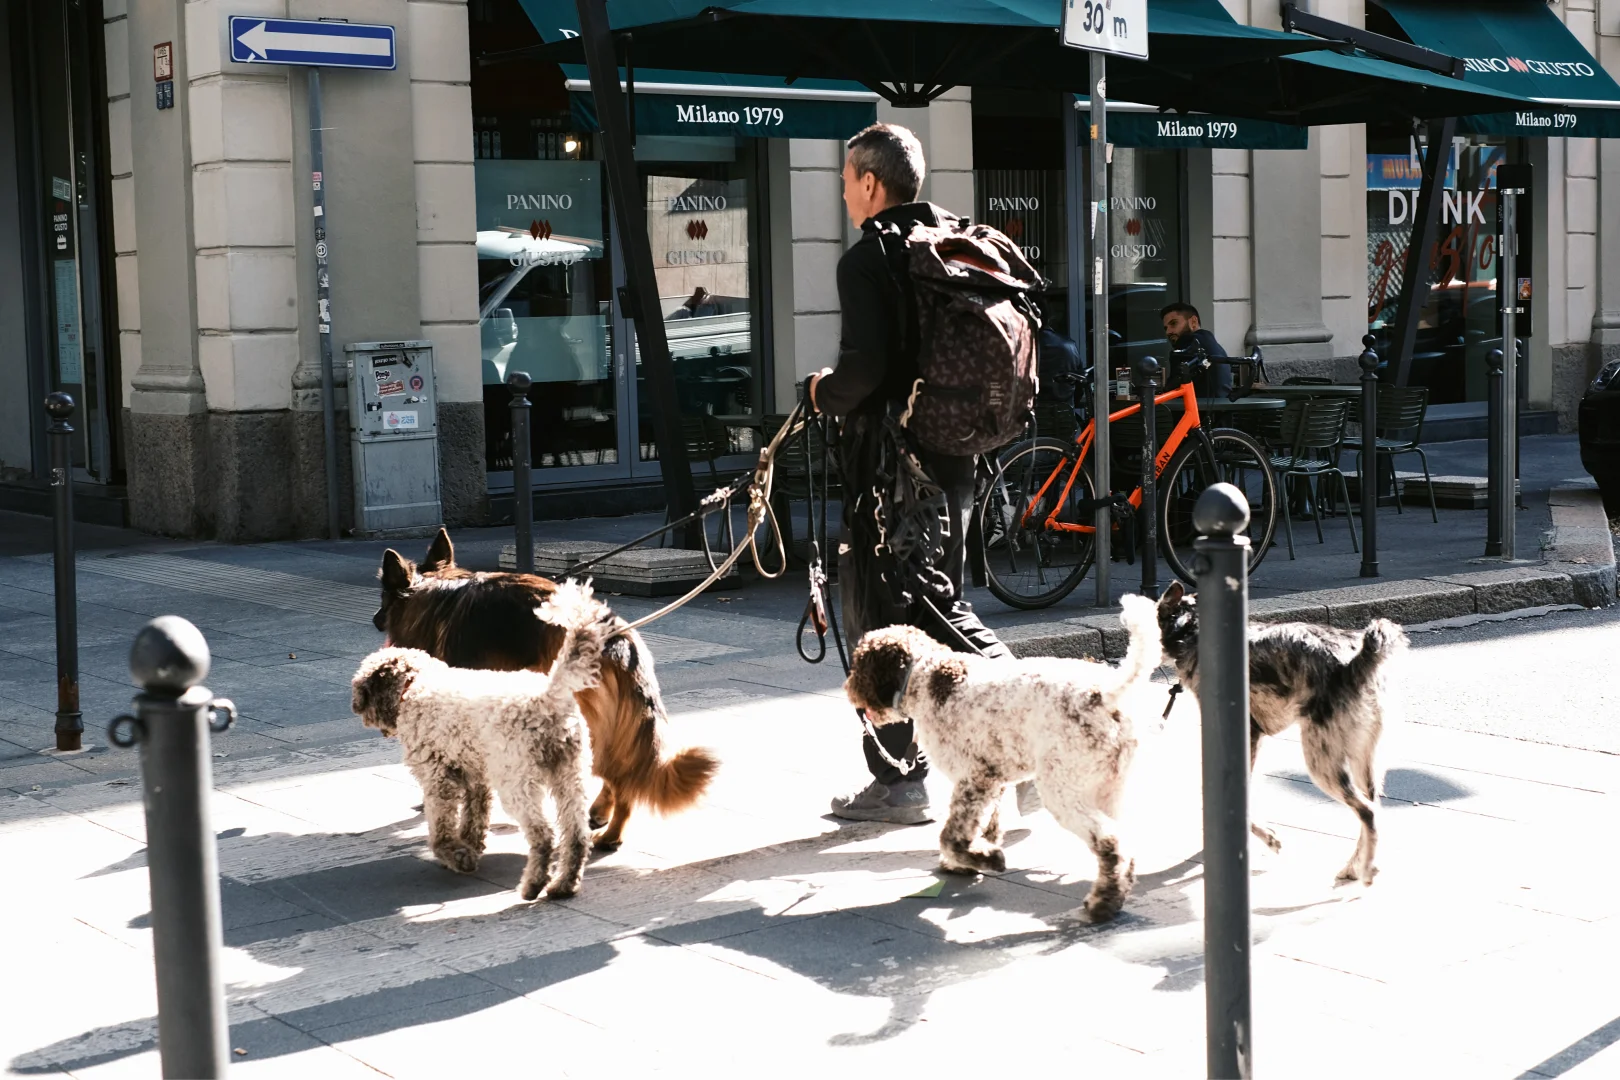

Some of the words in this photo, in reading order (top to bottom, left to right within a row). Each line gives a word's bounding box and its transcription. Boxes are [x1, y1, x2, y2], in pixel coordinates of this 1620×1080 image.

[1083, 1, 1104, 34] 30
[1113, 16, 1127, 38] m
[1463, 58, 1510, 72] NINO
[1525, 59, 1595, 77] GIUSTO
[676, 104, 740, 123] Milano
[743, 106, 784, 126] 1979
[1516, 112, 1551, 127] Milano
[1554, 113, 1577, 128] 1979
[1157, 120, 1204, 137] Milano
[1207, 121, 1238, 139] 1979
[1410, 135, 1466, 170] ET
[507, 194, 572, 210] PANINO
[666, 195, 727, 211] PANINO
[989, 197, 1039, 211] PANINO
[1110, 197, 1157, 210] PANINO
[1388, 190, 1487, 225] DNK
[53, 213, 68, 222] PANINO
[54, 223, 68, 231] GIUSTO
[509, 251, 575, 267] GIUSTO
[666, 250, 726, 265] GIUSTO
[1110, 244, 1157, 258] GIUSTO
